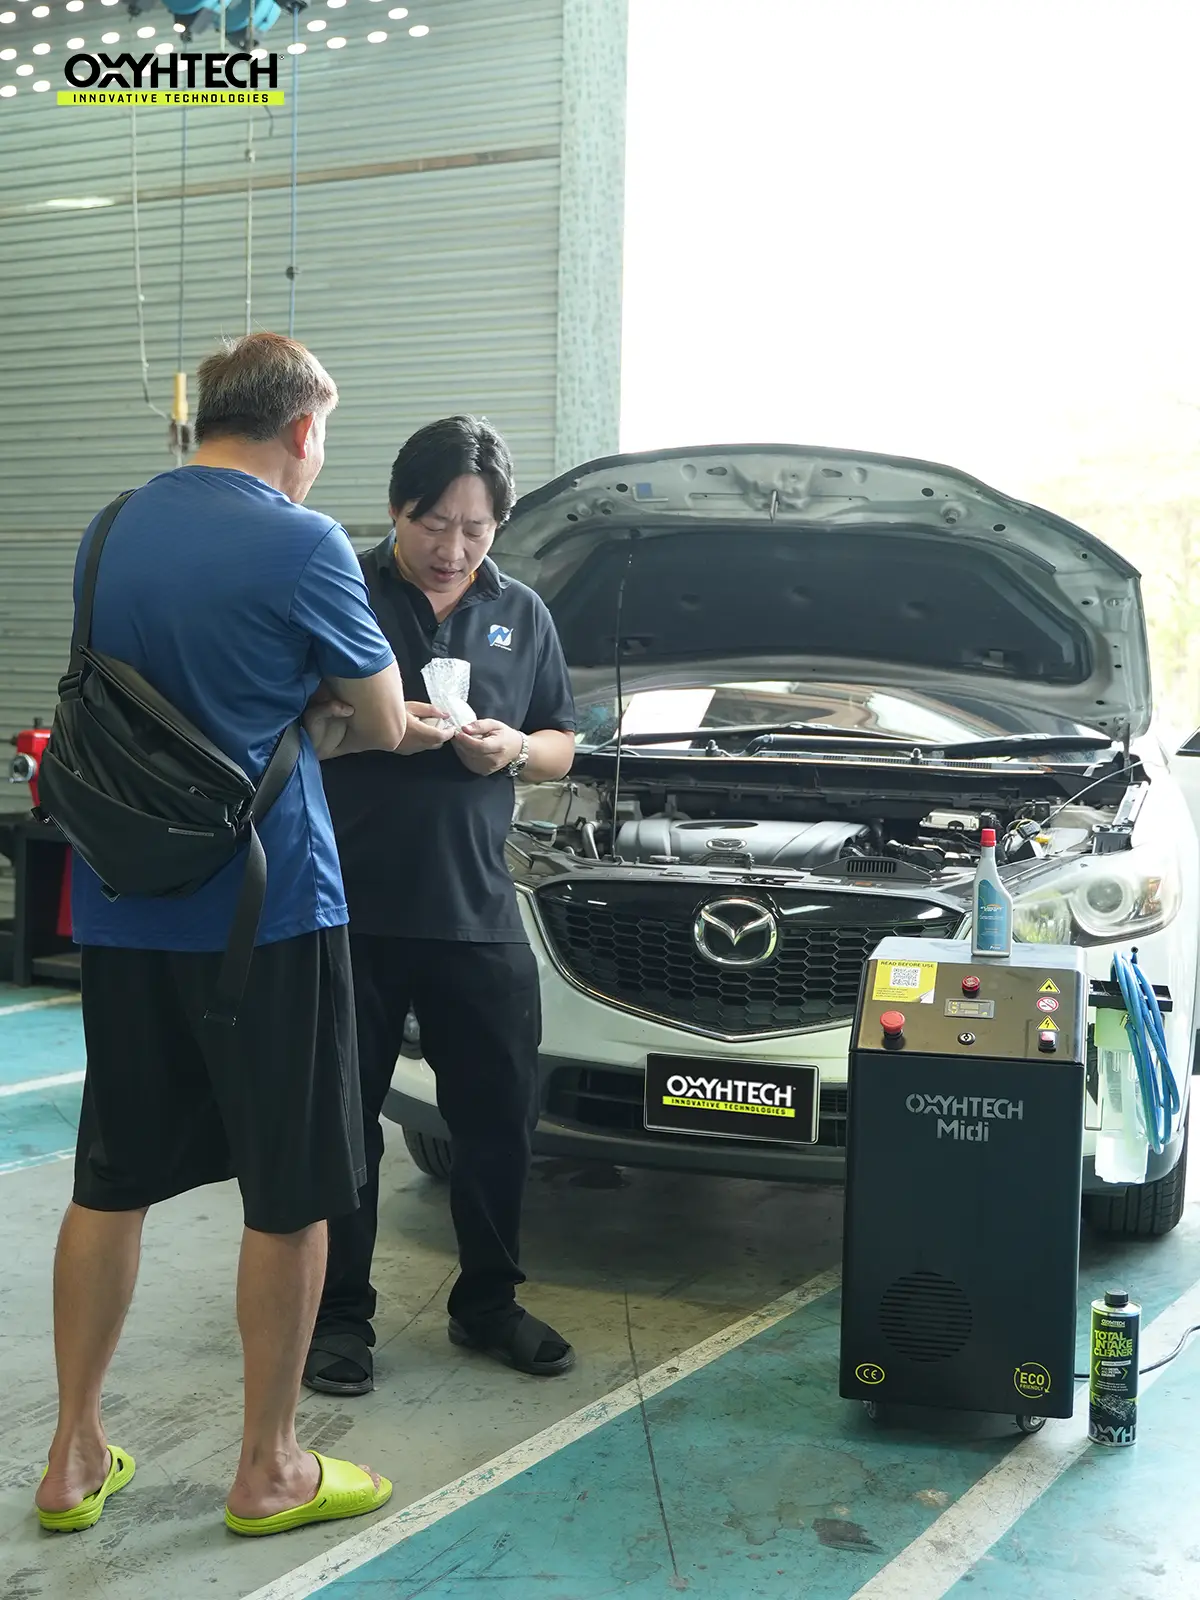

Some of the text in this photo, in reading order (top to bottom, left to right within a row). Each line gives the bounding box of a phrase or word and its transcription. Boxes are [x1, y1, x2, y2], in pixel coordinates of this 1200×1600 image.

[667, 1075, 792, 1107] OXYHTECH
[672, 1099, 786, 1115] INNOVATIVE TECHNOLOGIES
[905, 1093, 1024, 1120] OXYHTECH
[936, 1118, 989, 1142] Midi
[1095, 1330, 1126, 1340] TOTAL
[1096, 1339, 1132, 1349] INTAKE
[1094, 1348, 1132, 1357] CLEANER
[863, 1368, 878, 1380] CE
[1020, 1371, 1045, 1386] ECO
